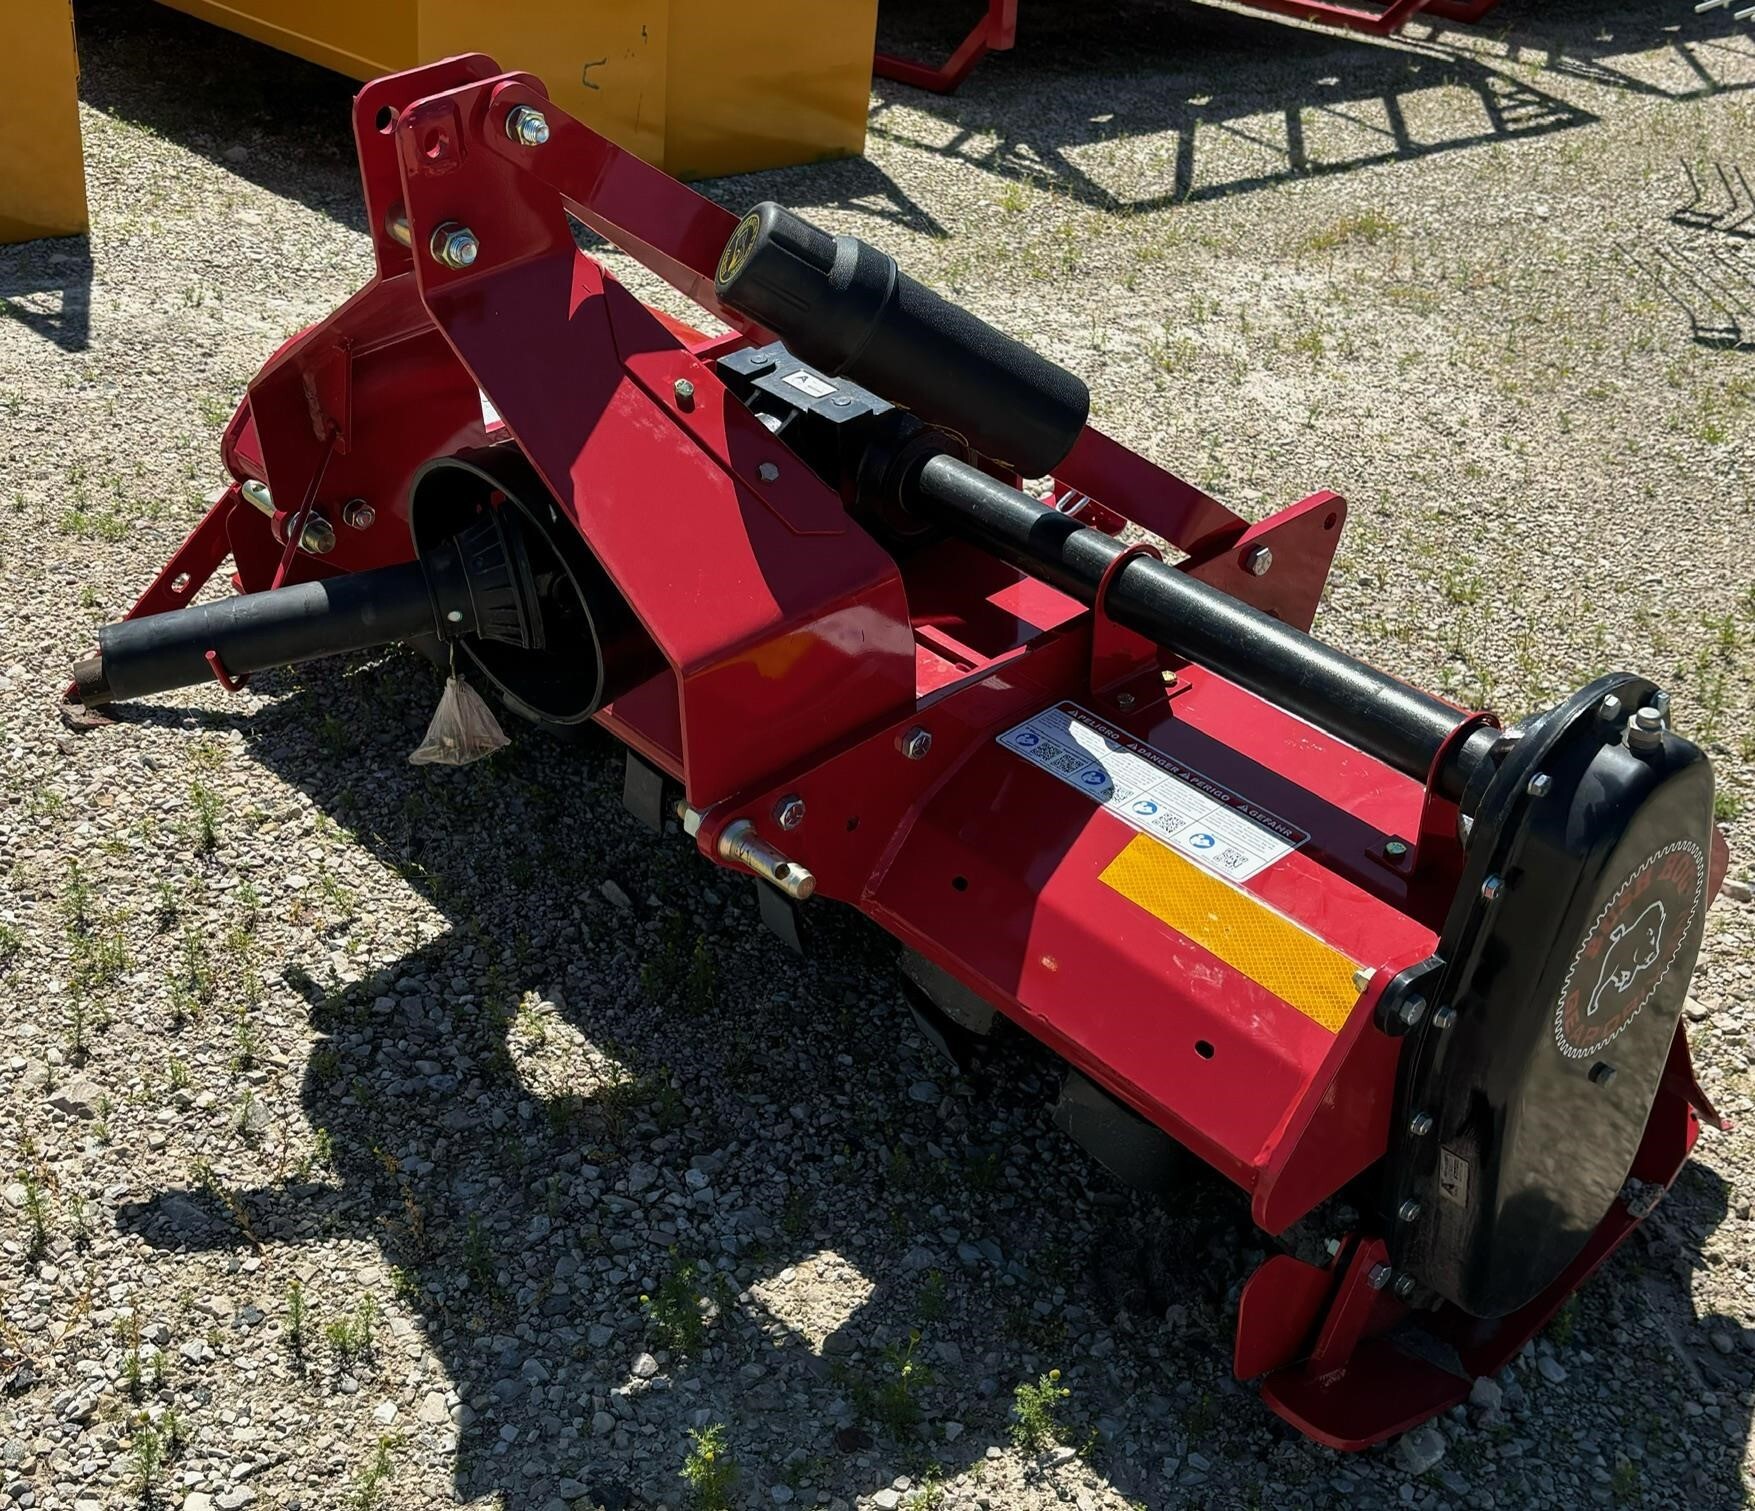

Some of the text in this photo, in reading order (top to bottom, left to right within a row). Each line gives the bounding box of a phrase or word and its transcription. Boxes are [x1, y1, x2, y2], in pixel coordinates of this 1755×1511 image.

[1077, 715, 1120, 740] PELIGRO
[1137, 748, 1180, 773] DANGER
[1190, 777, 1230, 802] PERIGO
[1249, 810, 1293, 837] GEFAHR
[1659, 853, 1698, 896] HOG
[1564, 988, 1601, 1046] GEAR
